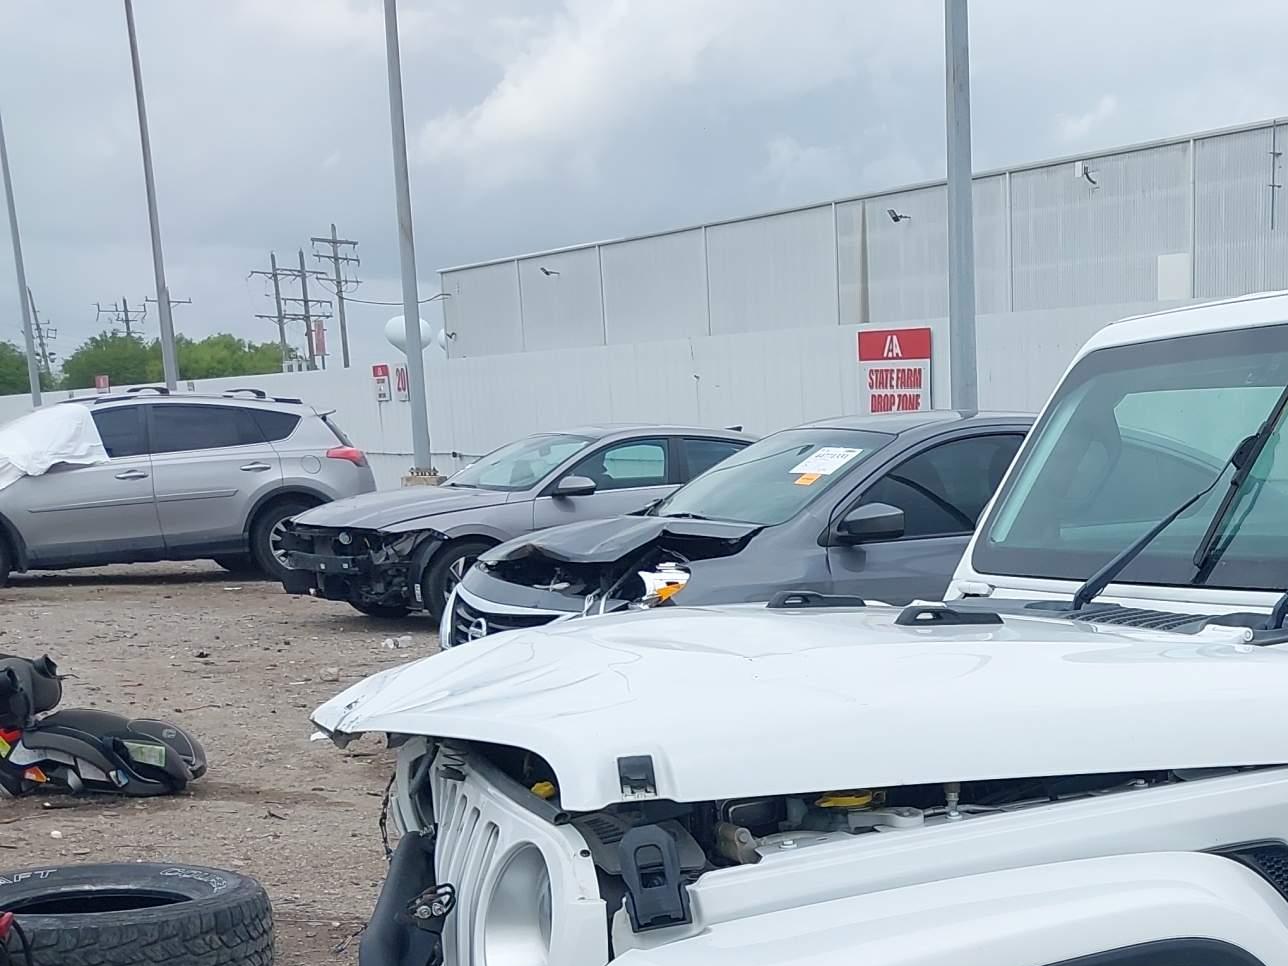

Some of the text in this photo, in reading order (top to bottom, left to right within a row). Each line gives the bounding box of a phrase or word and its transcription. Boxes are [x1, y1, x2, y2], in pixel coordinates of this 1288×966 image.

[396, 367, 406, 392] 20
[868, 367, 922, 390] STATE FARM
[871, 394, 895, 413] DROP
